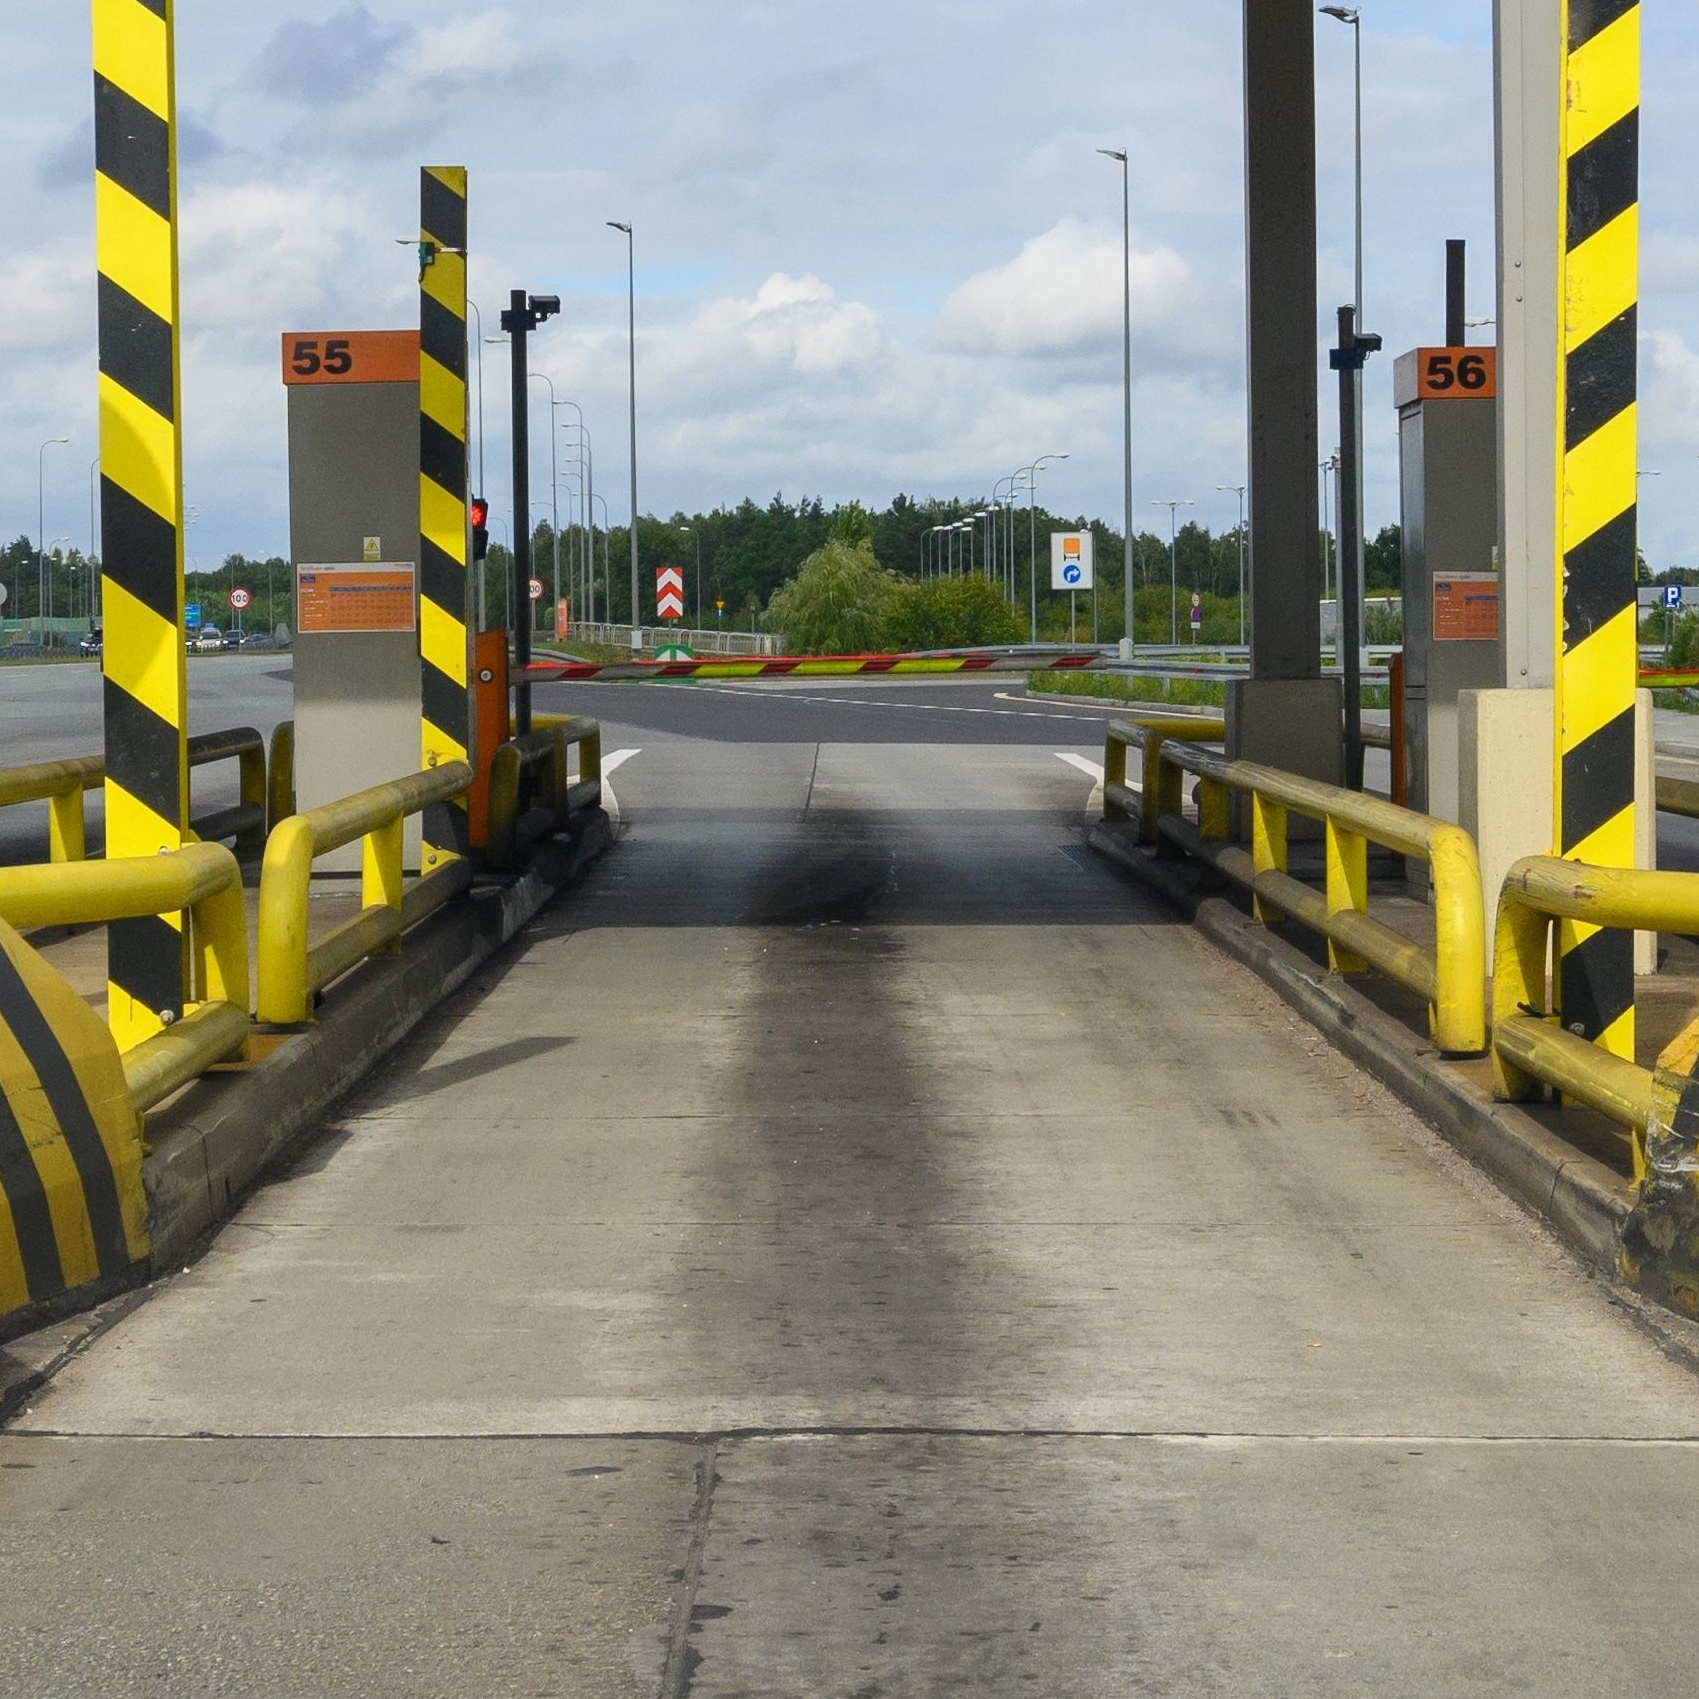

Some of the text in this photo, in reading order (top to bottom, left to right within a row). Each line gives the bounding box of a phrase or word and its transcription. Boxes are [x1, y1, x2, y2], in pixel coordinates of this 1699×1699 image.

[292, 340, 352, 376] 55
[1426, 354, 1487, 391] 56
[232, 594, 248, 603] 100
[1667, 587, 1679, 603] P
